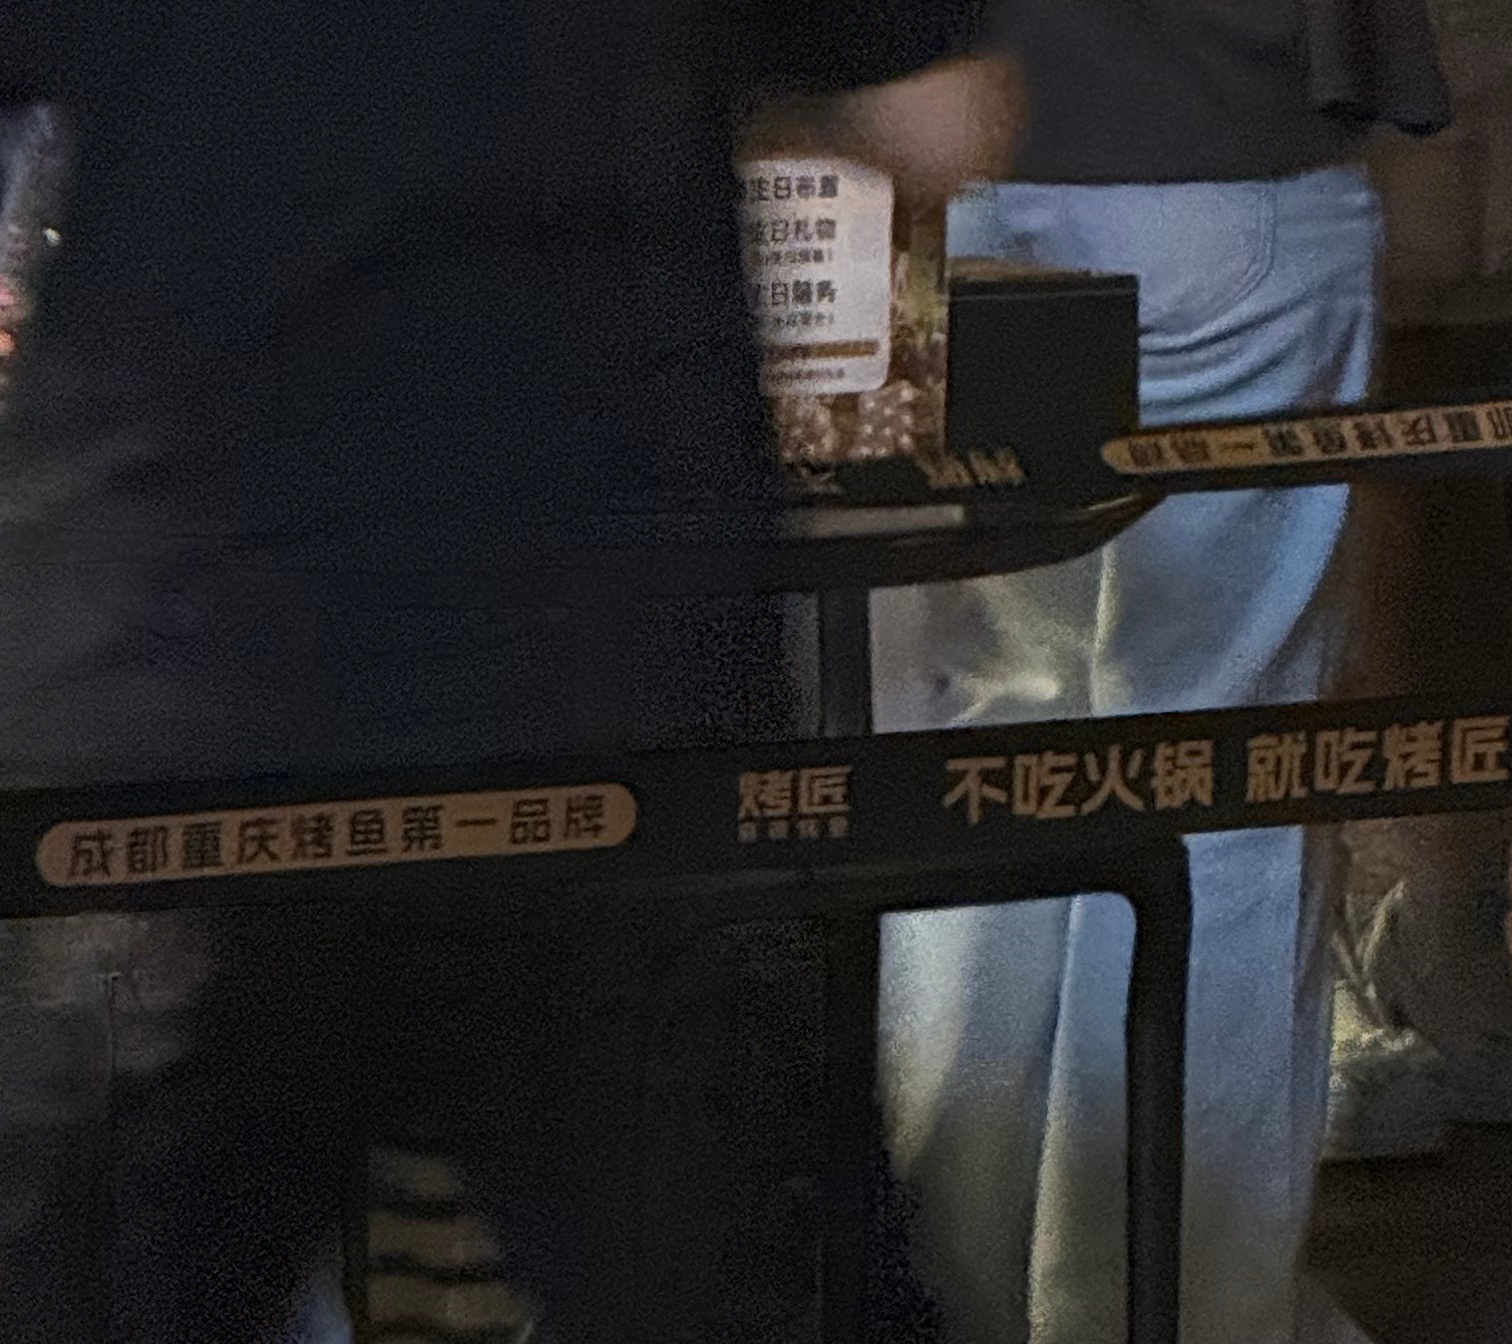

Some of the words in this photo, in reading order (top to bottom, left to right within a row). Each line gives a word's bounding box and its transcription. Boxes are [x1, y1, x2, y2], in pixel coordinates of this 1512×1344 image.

[738, 764, 854, 822] 烤匠
[944, 740, 1215, 824] 不吃火锅
[1244, 716, 1511, 804] 就吃烤匠
[67, 794, 607, 879] 成都重庆烤鱼第一品牌
